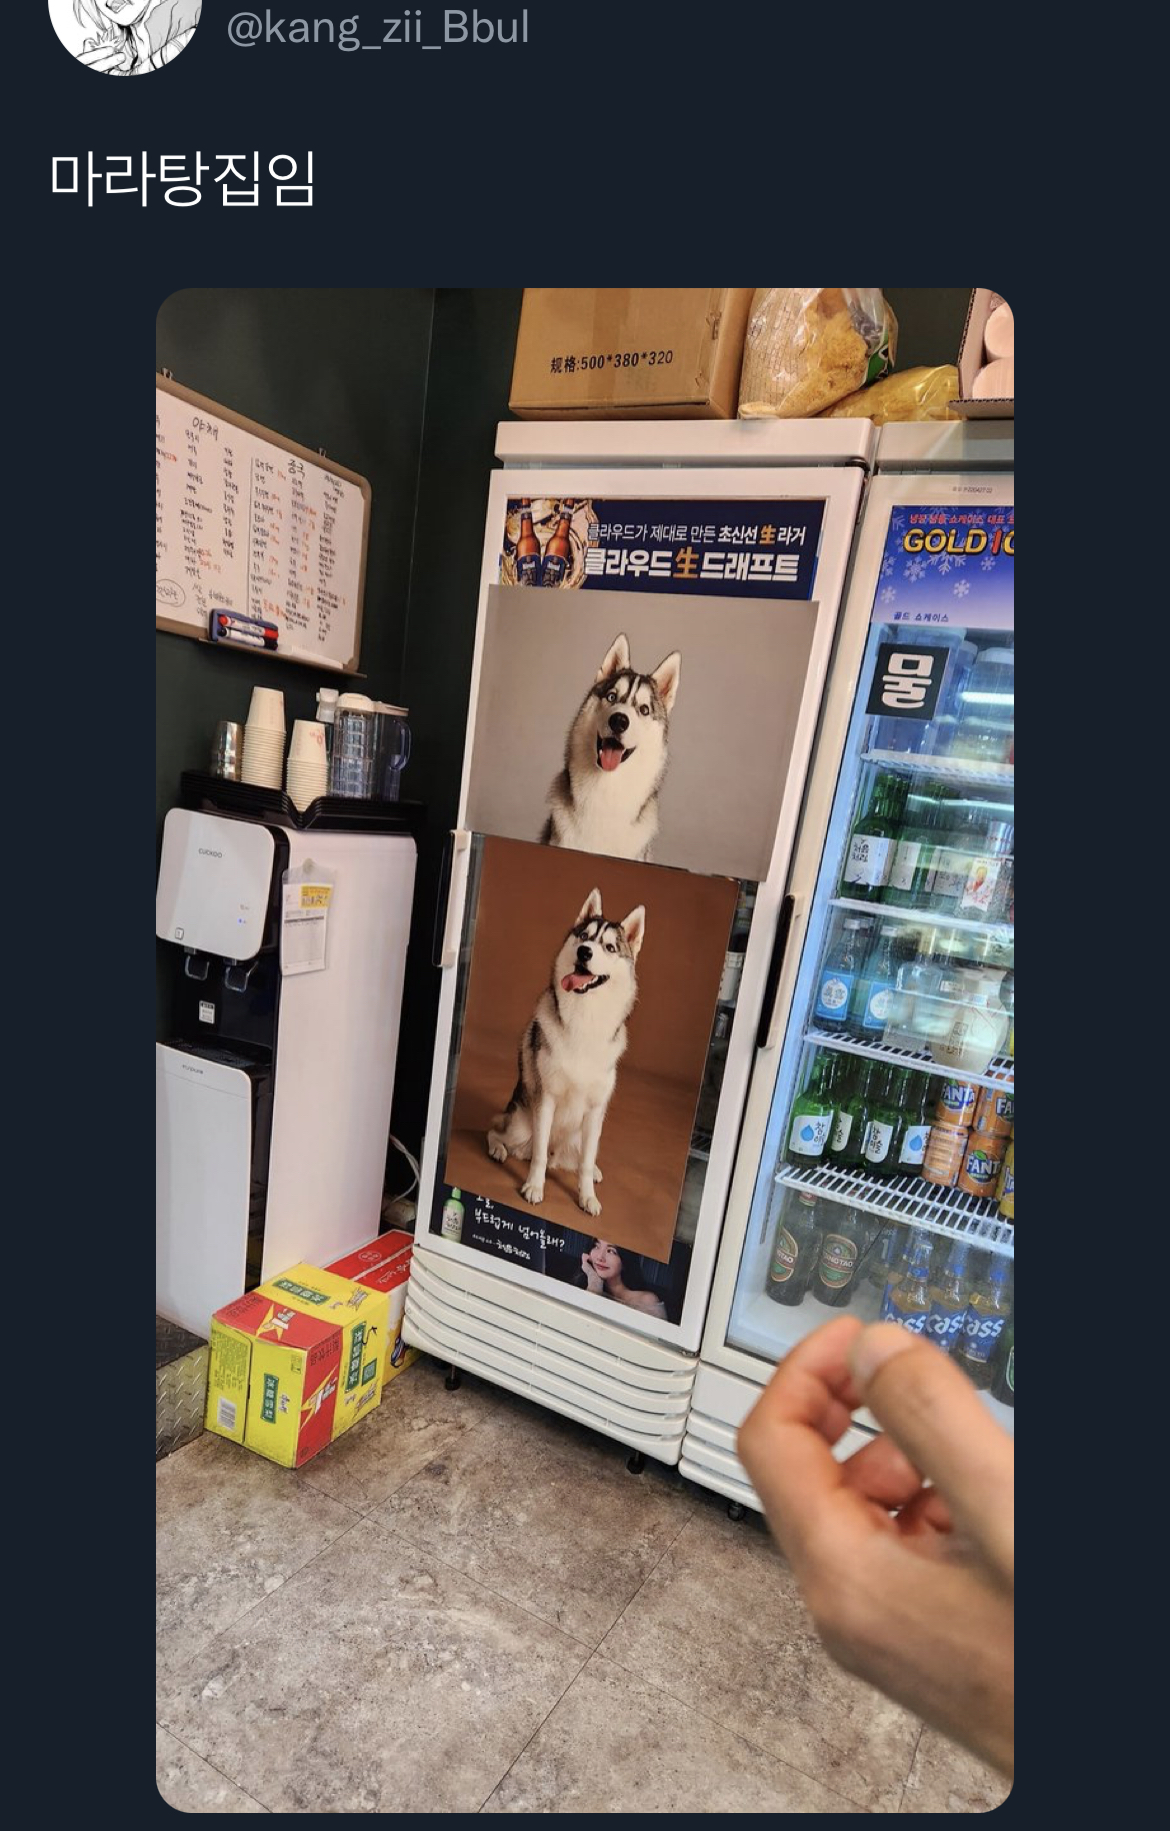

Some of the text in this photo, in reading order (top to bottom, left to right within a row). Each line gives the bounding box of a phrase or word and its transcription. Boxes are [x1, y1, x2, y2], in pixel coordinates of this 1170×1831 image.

[587, 523, 806, 546] 클라우드가 제대로 만든 초신선 生 라거
[902, 527, 988, 555] GOLD
[893, 611, 949, 622] 골드 쇼케이스
[881, 653, 935, 709] 물
[996, 1096, 1015, 1116] FA
[474, 1207, 514, 1231] 부드럽게
